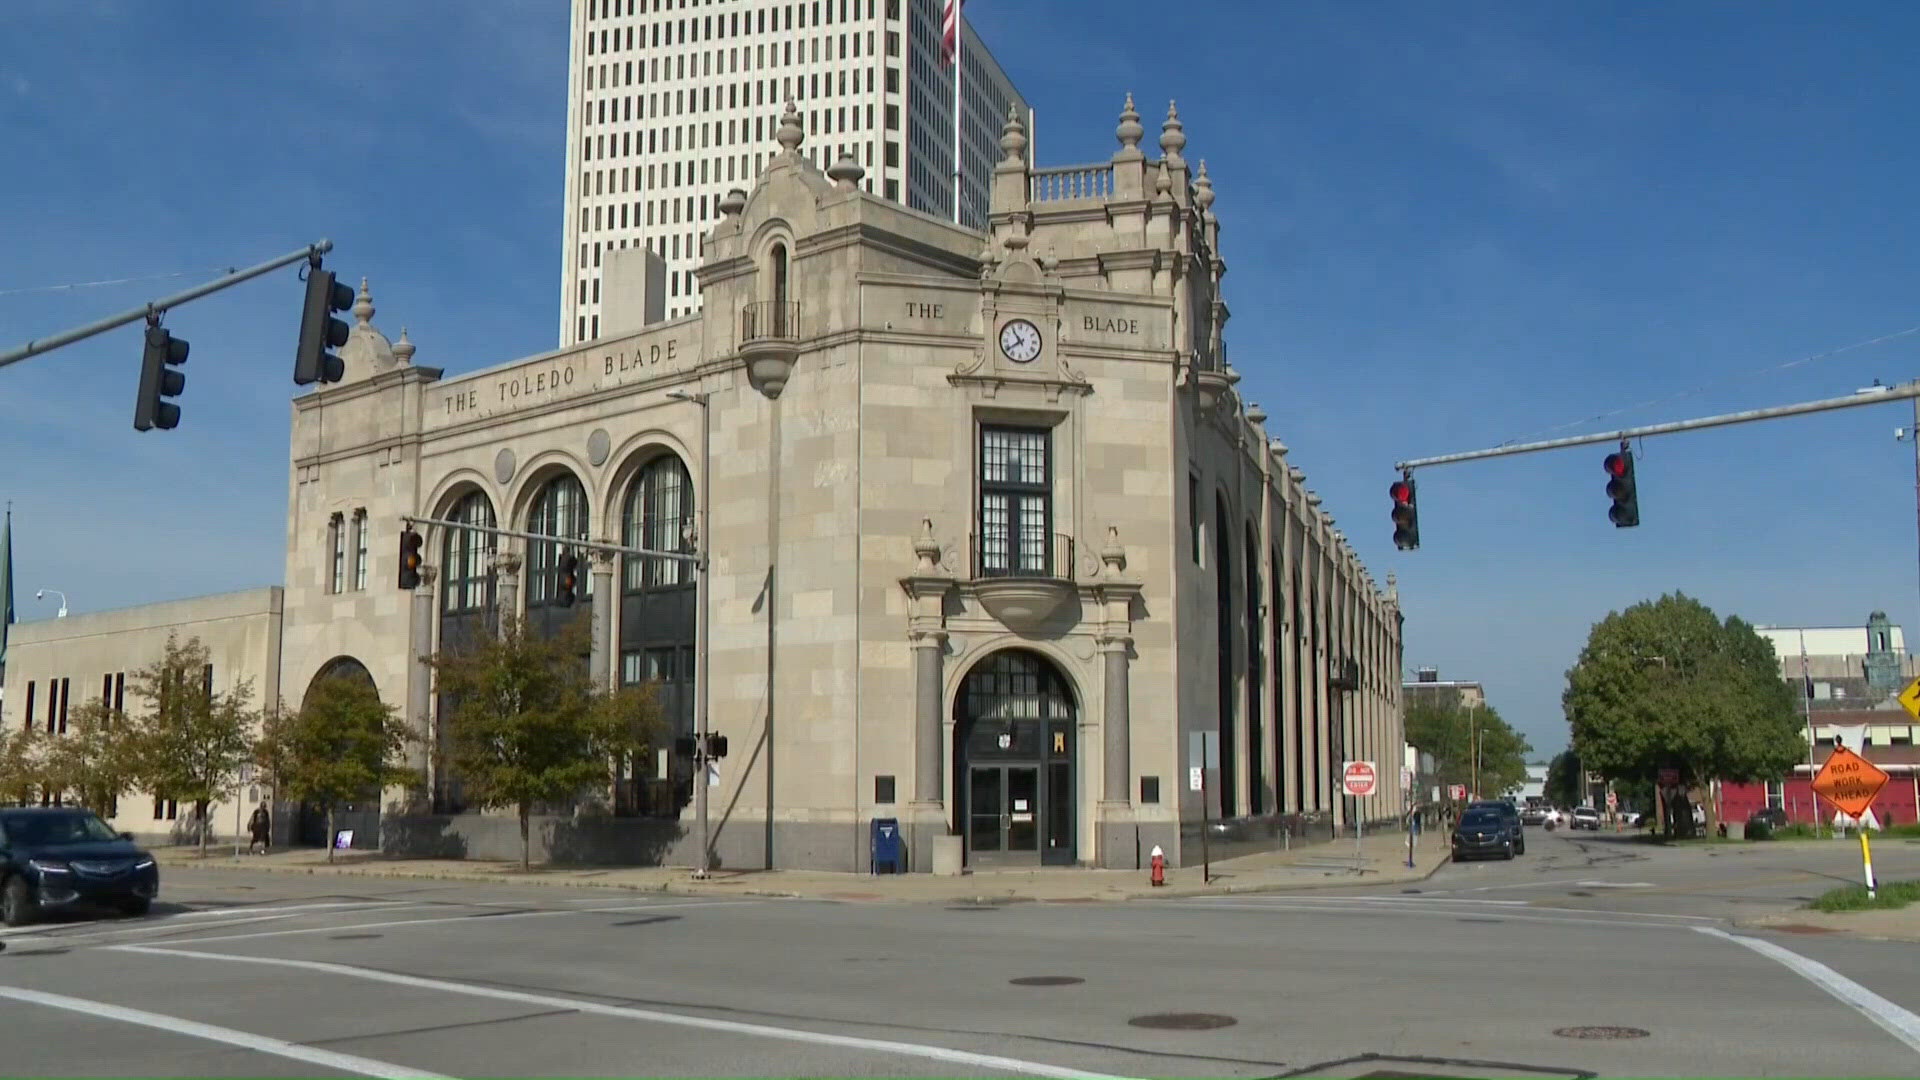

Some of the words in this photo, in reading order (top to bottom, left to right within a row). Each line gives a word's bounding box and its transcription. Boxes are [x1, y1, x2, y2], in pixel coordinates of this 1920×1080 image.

[906, 302, 943, 319] THE
[1083, 316, 1139, 334] BLADE
[445, 390, 477, 415] THE
[499, 366, 575, 401] TOLEDO
[605, 339, 678, 375] BLADE
[1830, 762, 1860, 774] ROAD
[1833, 776, 1863, 788] WORK
[1834, 789, 1870, 801] AHEAD
